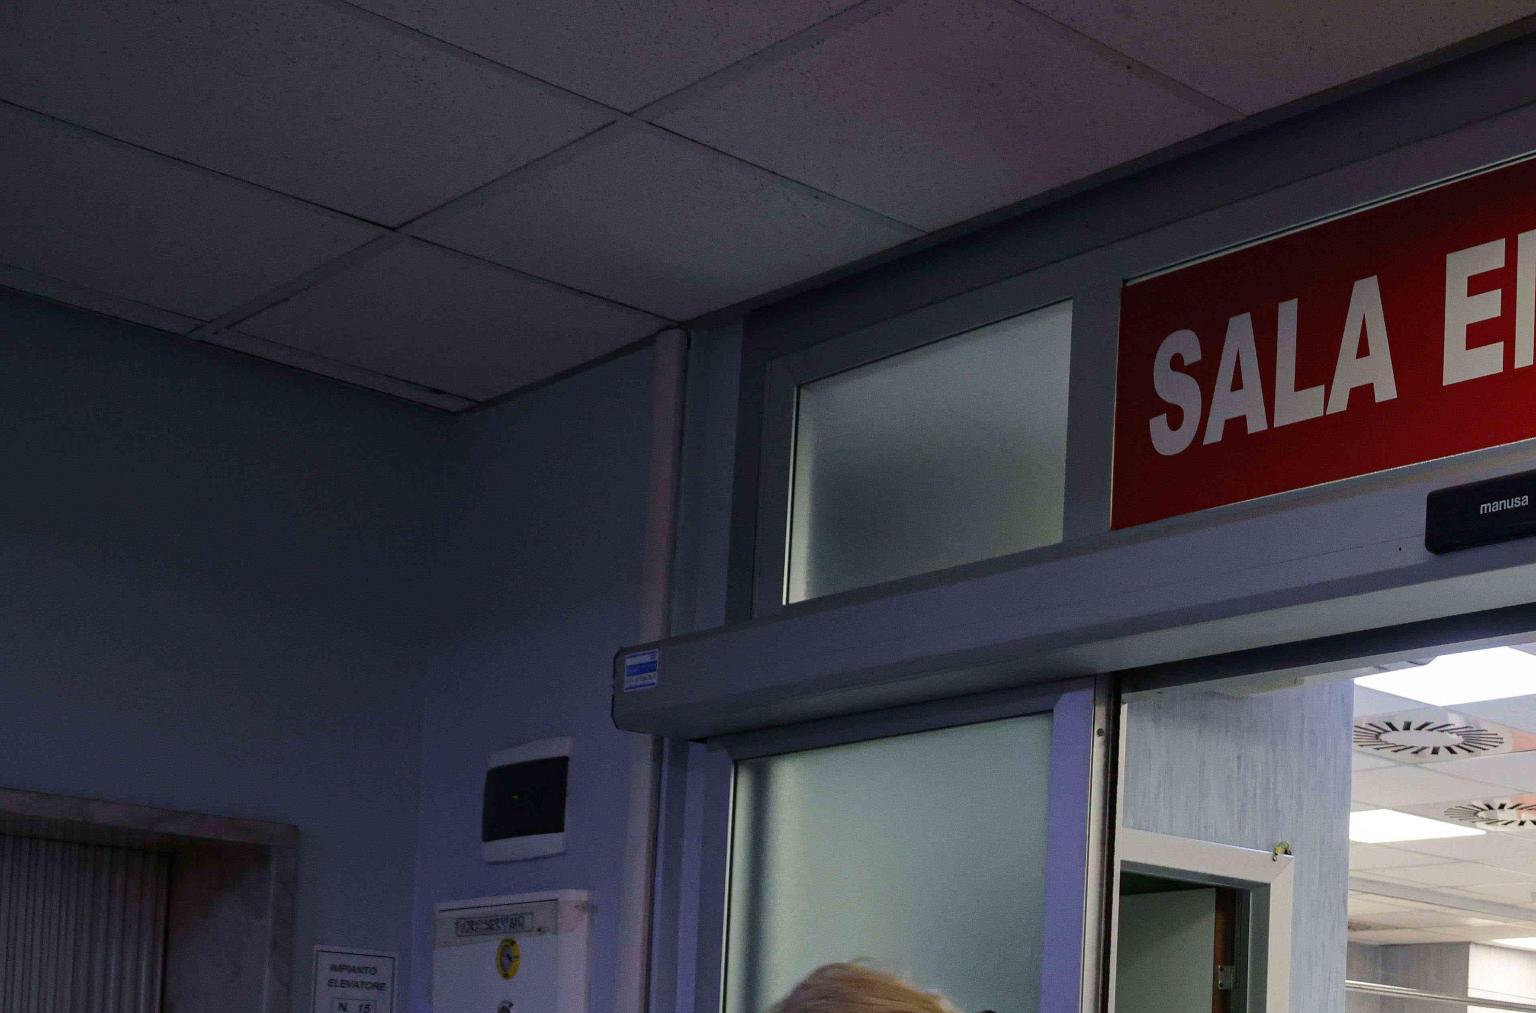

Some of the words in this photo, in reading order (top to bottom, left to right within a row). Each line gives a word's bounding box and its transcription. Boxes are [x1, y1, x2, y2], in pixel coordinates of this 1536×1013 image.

[1149, 274, 1398, 456] SALA
[1479, 494, 1529, 515] manusa
[327, 978, 387, 992] ELEVATORE
